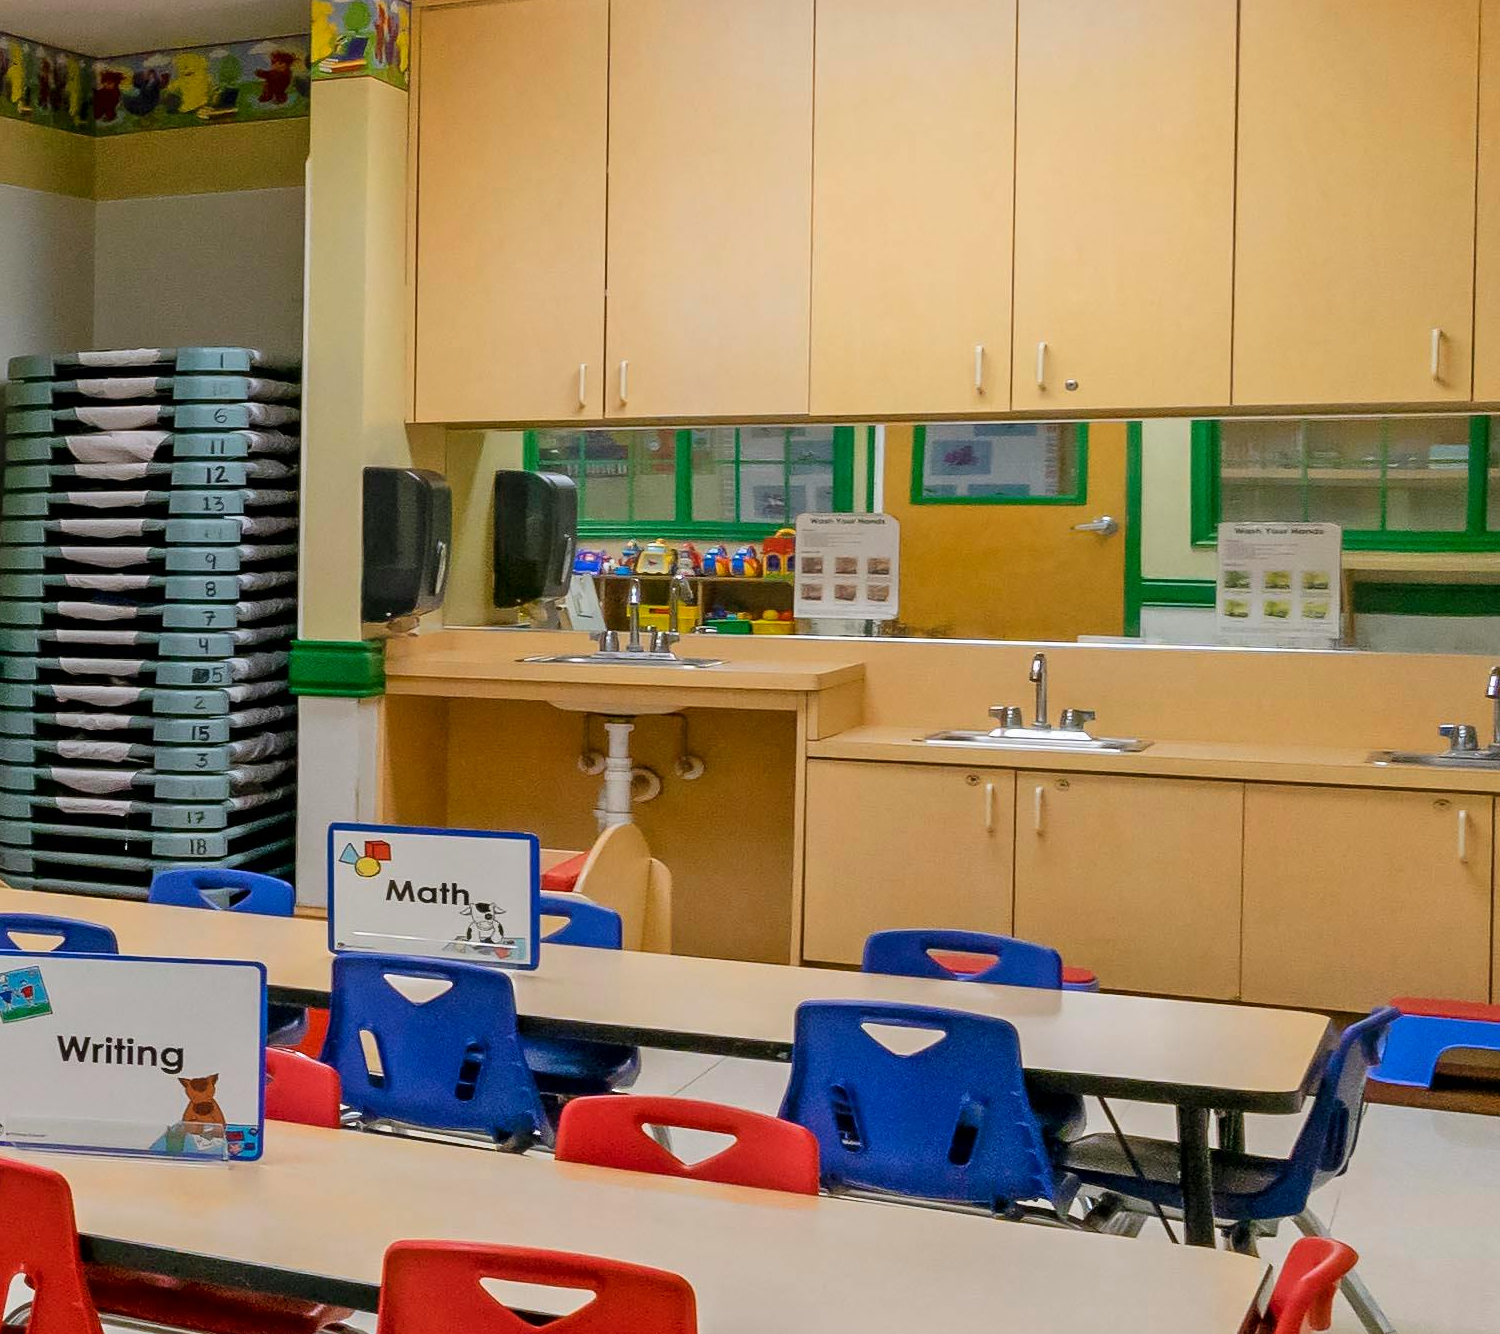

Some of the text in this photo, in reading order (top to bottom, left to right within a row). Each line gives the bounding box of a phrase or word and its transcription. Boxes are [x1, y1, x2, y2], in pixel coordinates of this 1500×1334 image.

[220, 352, 224, 369] 1
[213, 408, 228, 424] 6
[210, 439, 225, 455] 11
[206, 465, 229, 484] 12
[203, 496, 225, 512] 13
[1235, 527, 1324, 535] Wash Your Hands
[205, 553, 217, 570] 9
[205, 581, 217, 598] 8
[202, 610, 216, 626] 7
[198, 637, 209, 655] 4
[194, 695, 206, 710] 2
[191, 724, 210, 742] 15
[196, 752, 209, 768] 3
[187, 810, 206, 824] 17
[189, 838, 207, 856] 18
[385, 879, 470, 906] Math
[56, 1034, 185, 1075] Writing
